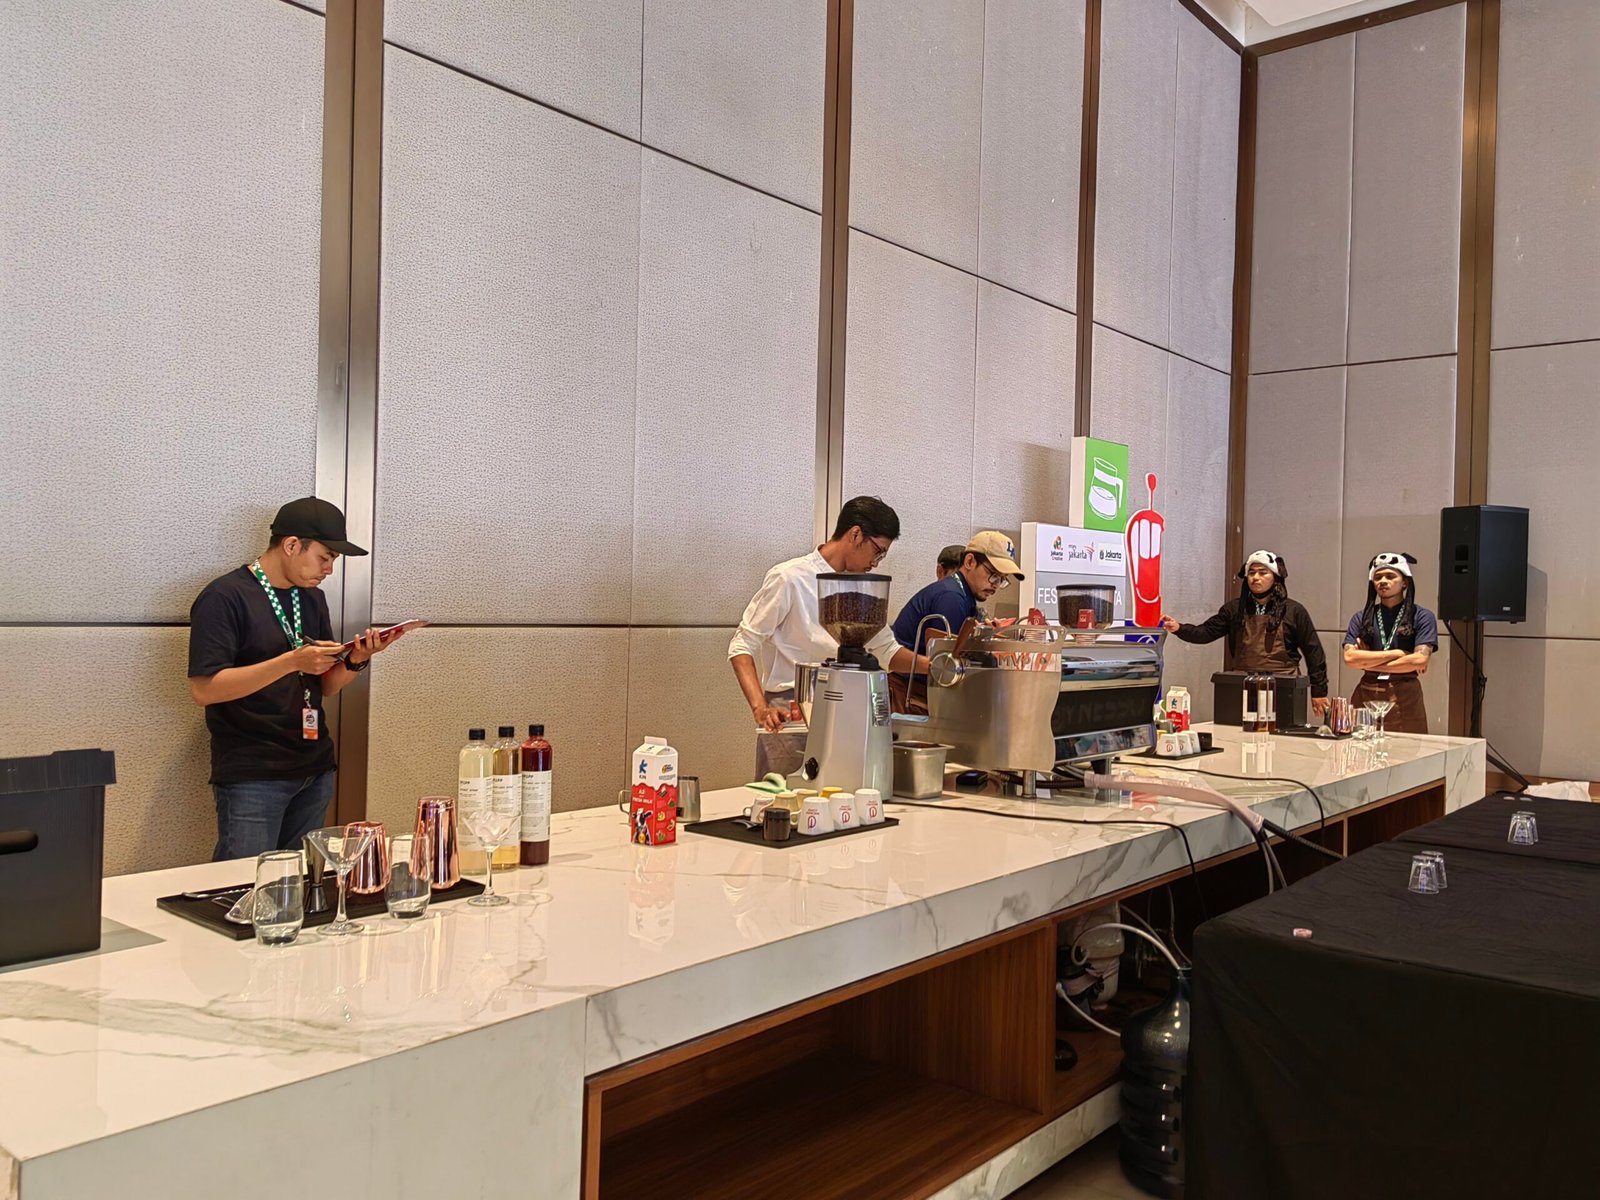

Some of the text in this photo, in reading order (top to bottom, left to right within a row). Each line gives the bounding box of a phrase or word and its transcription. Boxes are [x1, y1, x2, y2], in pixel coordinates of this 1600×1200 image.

[1068, 549, 1087, 561] jakarta
[1105, 550, 1122, 559] Jakarta
[1037, 588, 1057, 604] FES
[998, 654, 1031, 667] MVP
